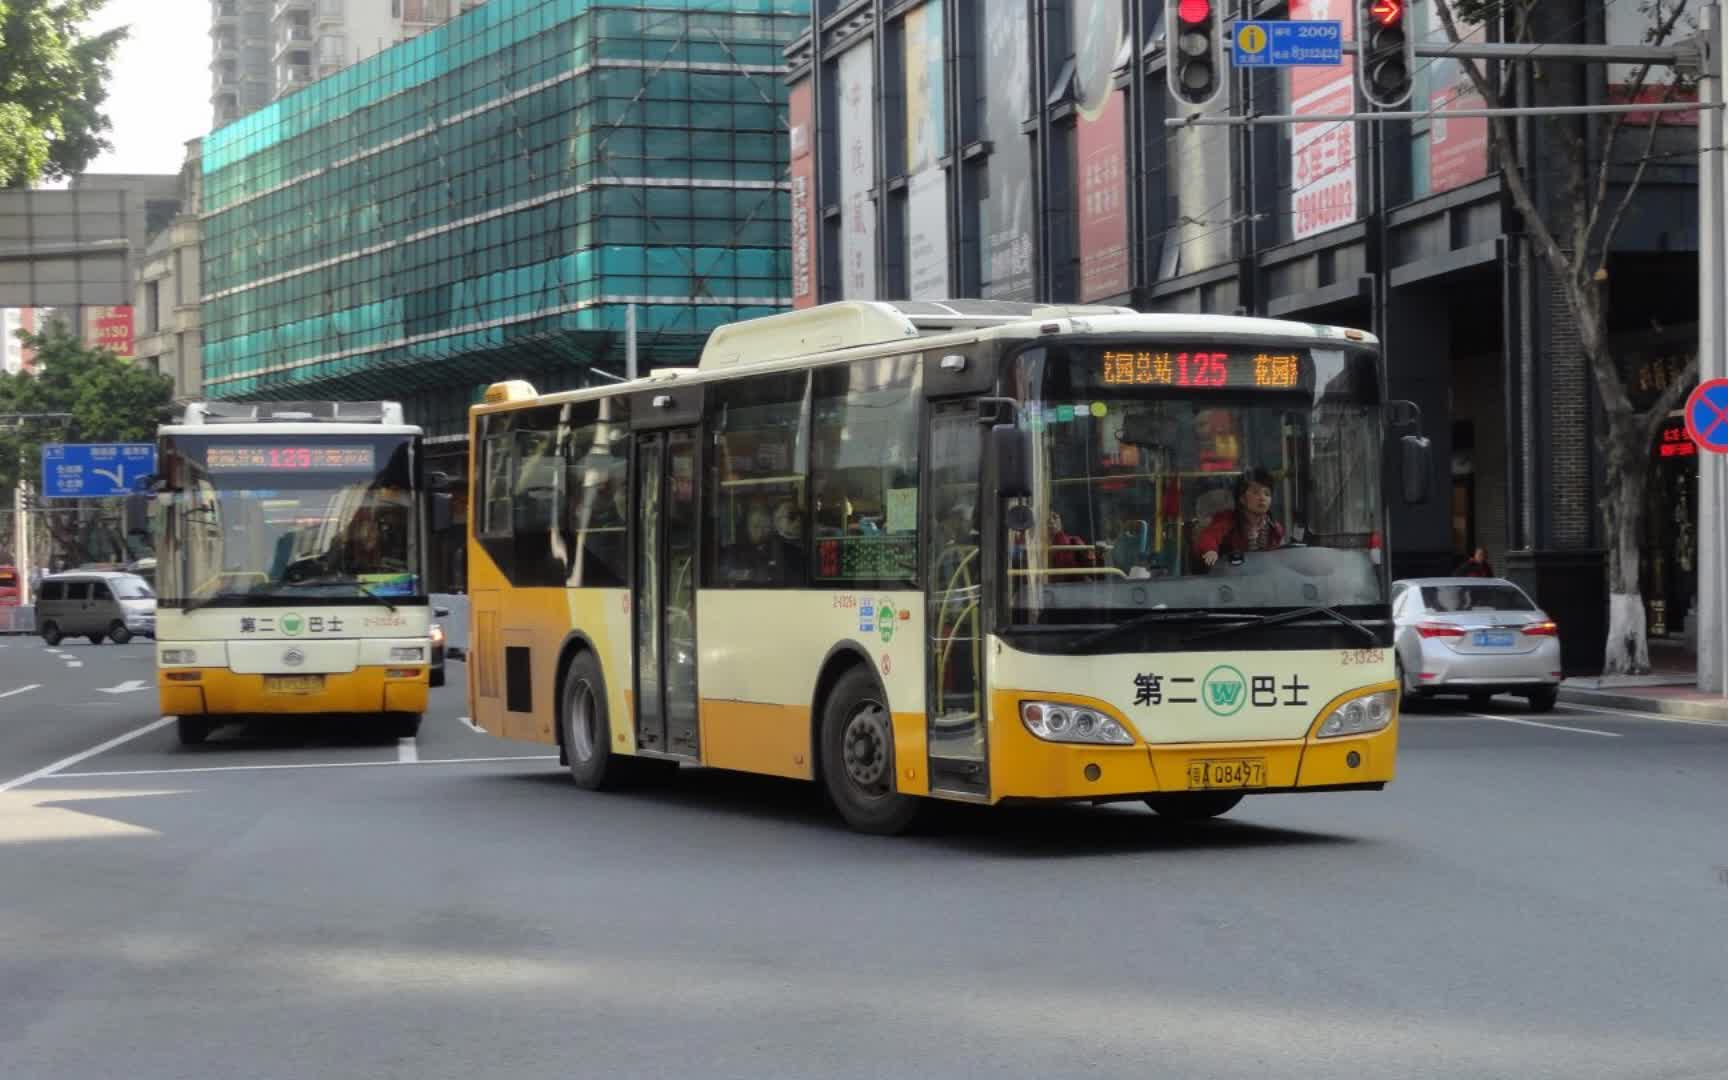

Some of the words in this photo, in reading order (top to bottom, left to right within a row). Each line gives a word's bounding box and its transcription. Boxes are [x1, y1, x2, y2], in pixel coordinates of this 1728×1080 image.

[1298, 26, 1337, 40] 2009
[1176, 352, 1229, 386] 125
[268, 447, 312, 469] 125
[240, 616, 275, 633] 第二
[308, 615, 344, 633] 巴士
[1341, 648, 1385, 665] 2-13254
[1133, 672, 1197, 707] 第二
[1251, 674, 1309, 707] 巴士
